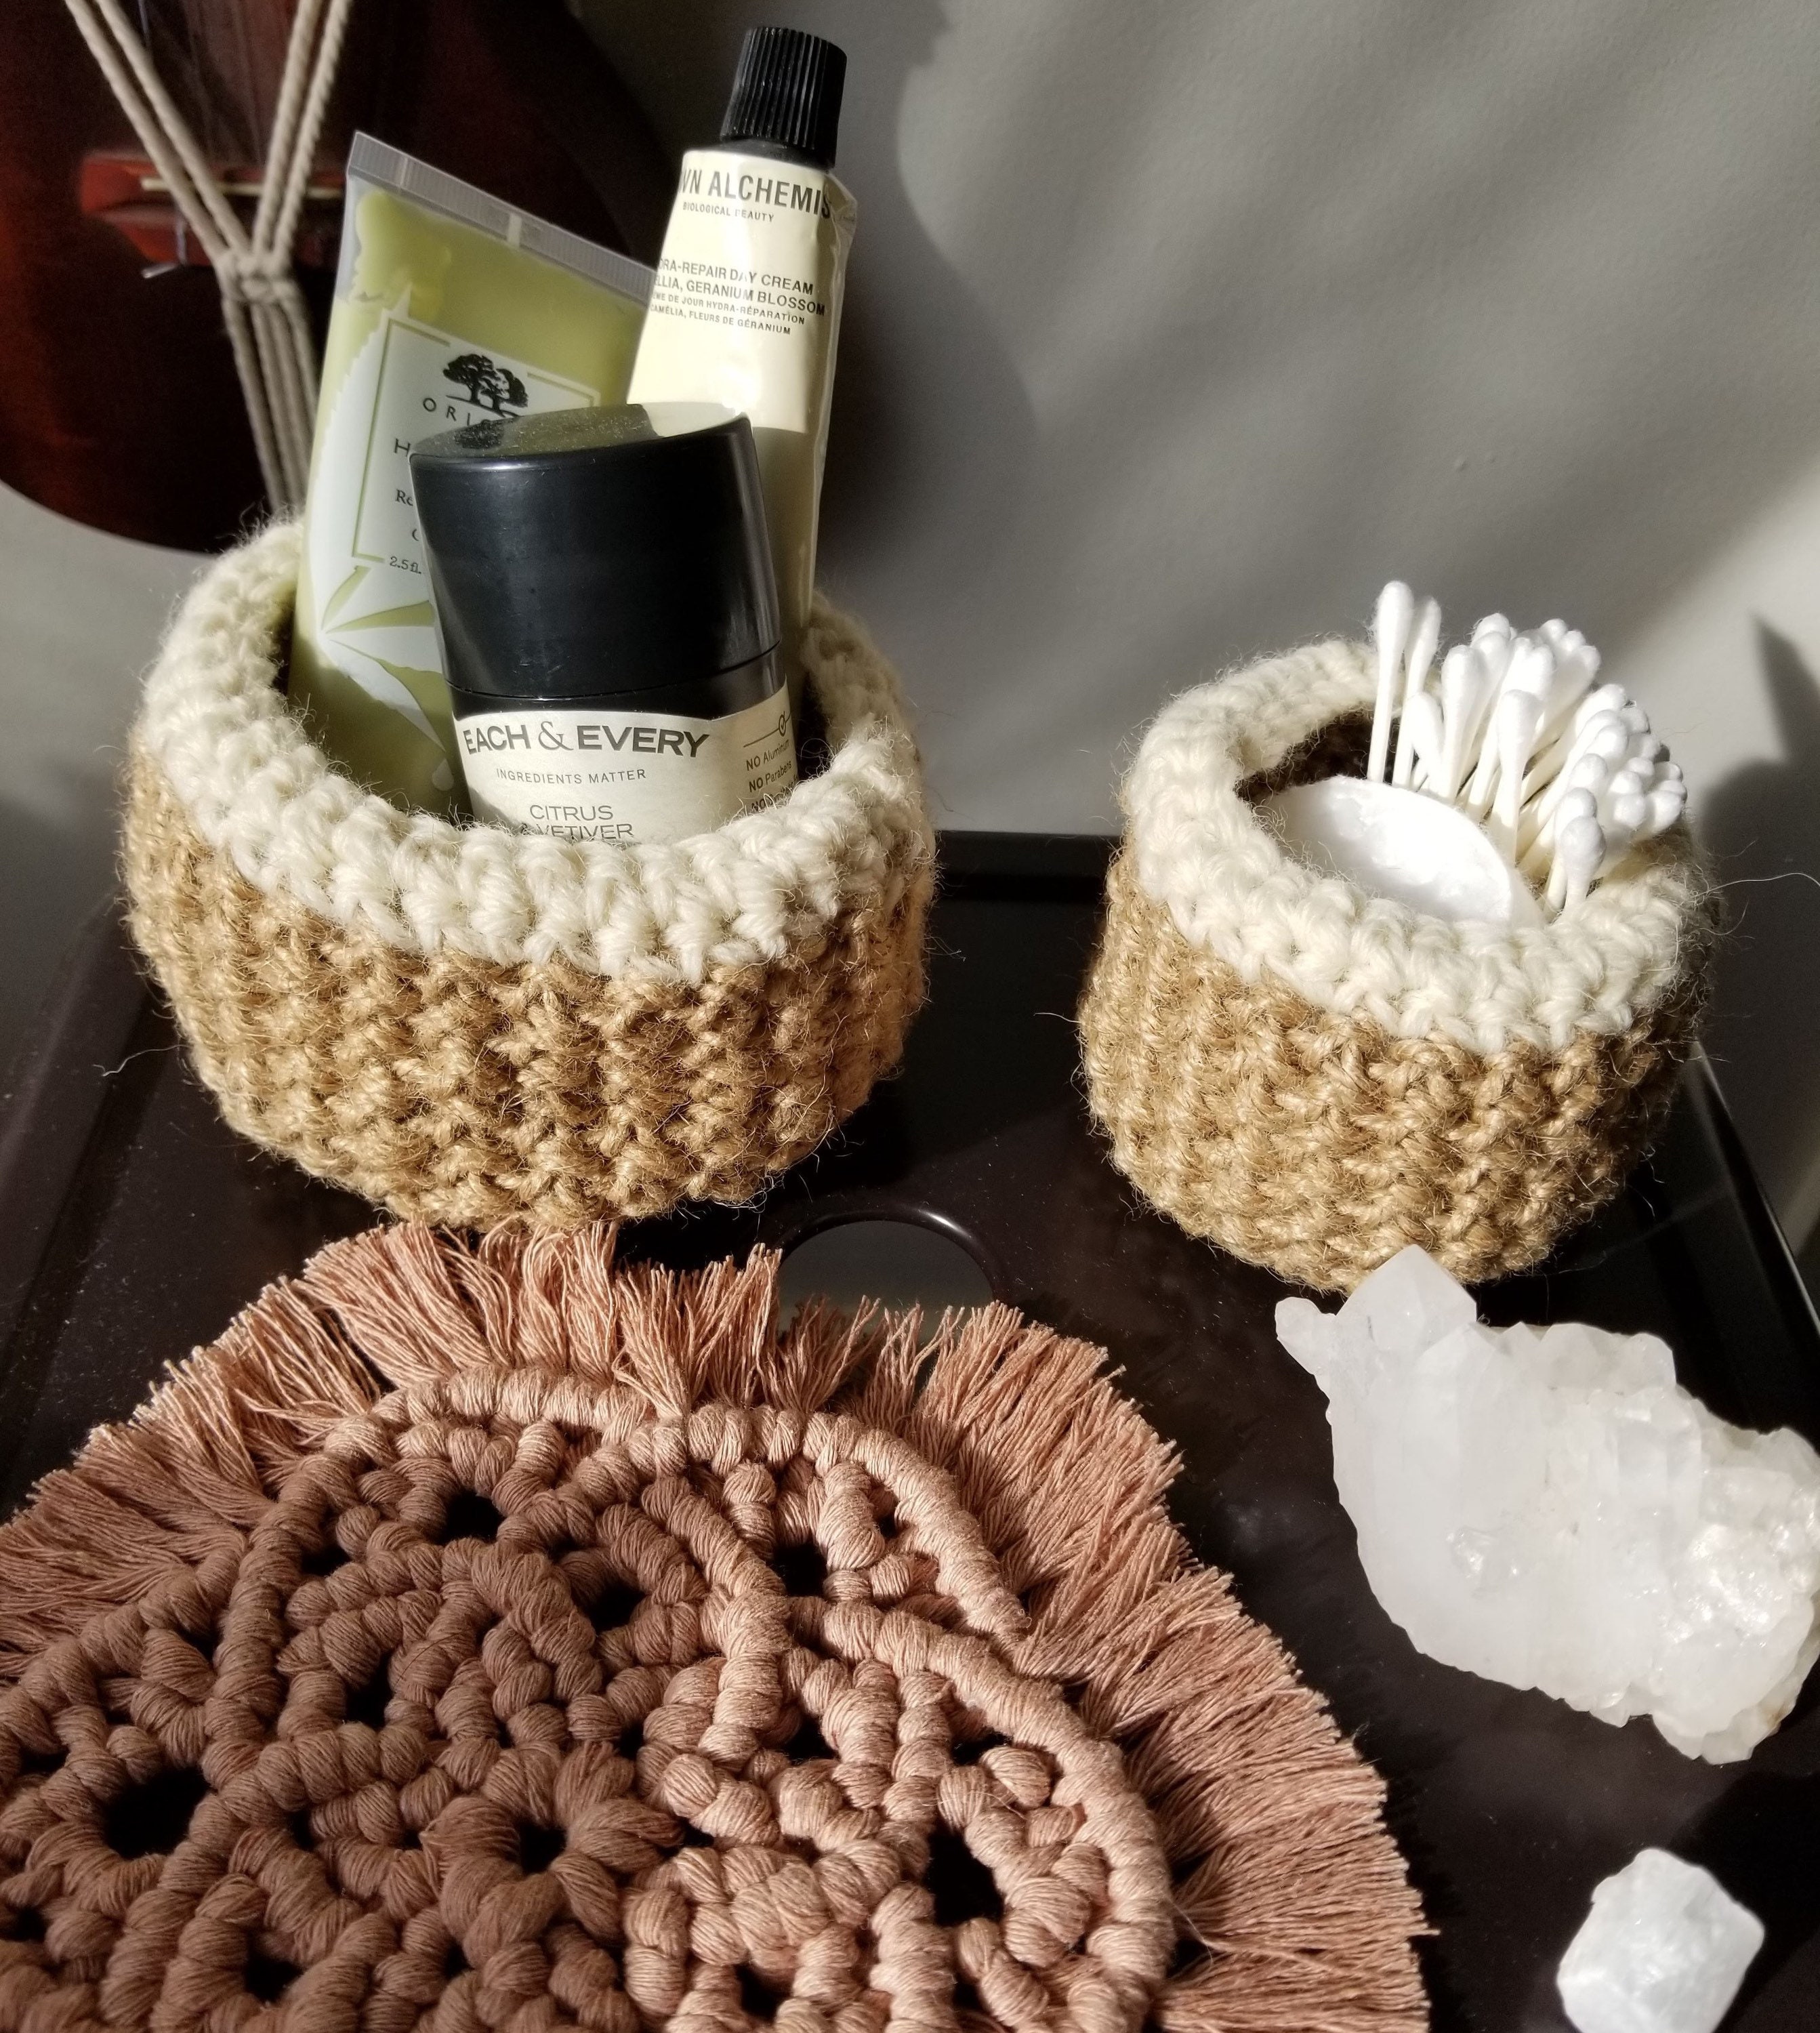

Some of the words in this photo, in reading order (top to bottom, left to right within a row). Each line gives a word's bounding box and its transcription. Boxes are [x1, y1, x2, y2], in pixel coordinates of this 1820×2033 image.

[682, 201, 730, 217] BIOLOGICAL
[735, 209, 774, 222] BEAUTY
[730, 268, 758, 284] DAY
[761, 274, 814, 295] CREAM
[667, 293, 679, 304] DE
[682, 297, 704, 308] JOUR
[686, 279, 753, 302] GERANIUM
[757, 291, 825, 316] BLOSSOM
[688, 310, 720, 323] FLEURS
[722, 316, 734, 326] DE
[737, 318, 791, 335] GÉRANIUM
[423, 397, 471, 426] ORI
[463, 724, 531, 755] EACH
[538, 721, 574, 751] &
[577, 725, 710, 758] EVERY
[746, 755, 760, 771] NO
[496, 768, 582, 784] INGREDIENTS
[588, 769, 646, 783] MATTER
[749, 777, 764, 793] NO
[530, 804, 614, 821] CITRUS
[536, 823, 635, 840] VETIVER
